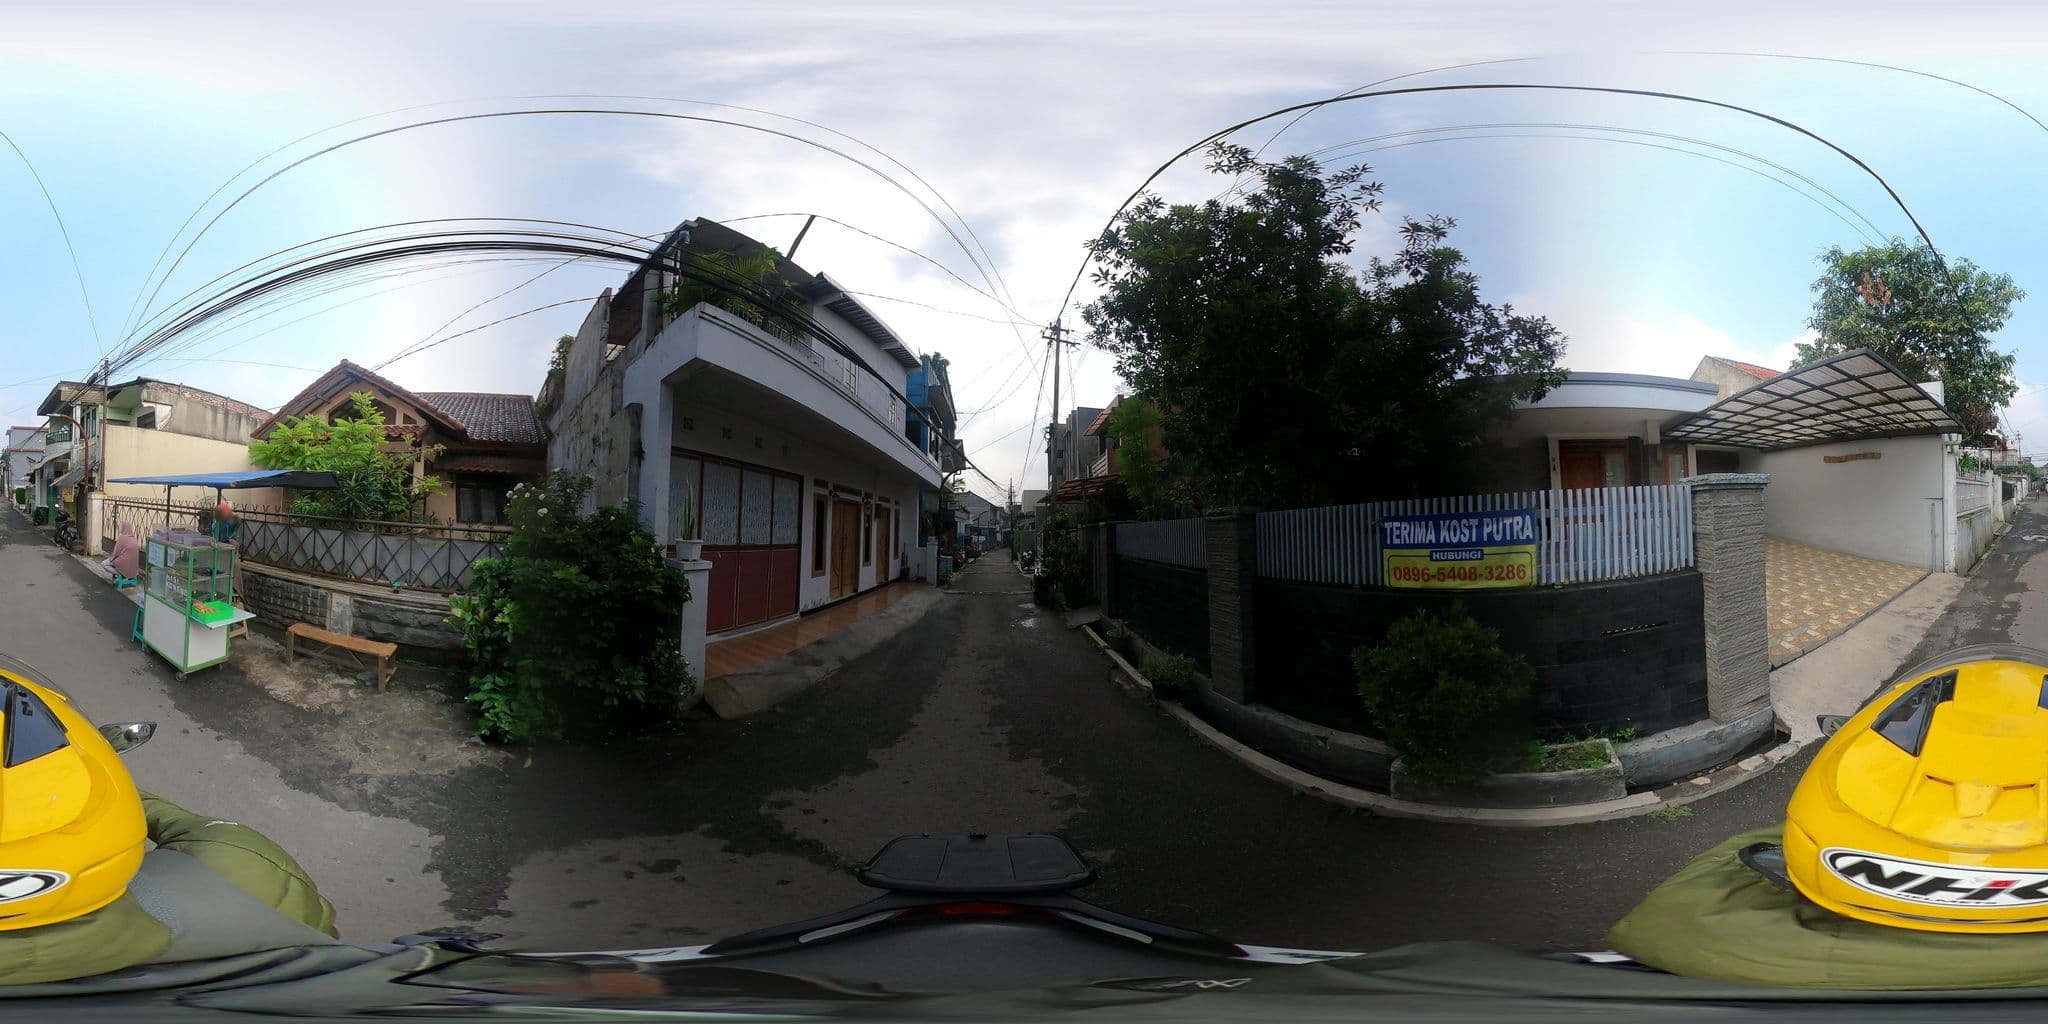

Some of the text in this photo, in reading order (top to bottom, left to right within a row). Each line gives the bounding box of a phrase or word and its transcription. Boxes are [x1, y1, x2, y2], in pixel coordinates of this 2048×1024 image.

[1384, 515, 1533, 545] TERIMA KOST PUTRA
[1432, 551, 1481, 560] HUBUNGI
[1393, 564, 1526, 582] 0896-5408-3286
